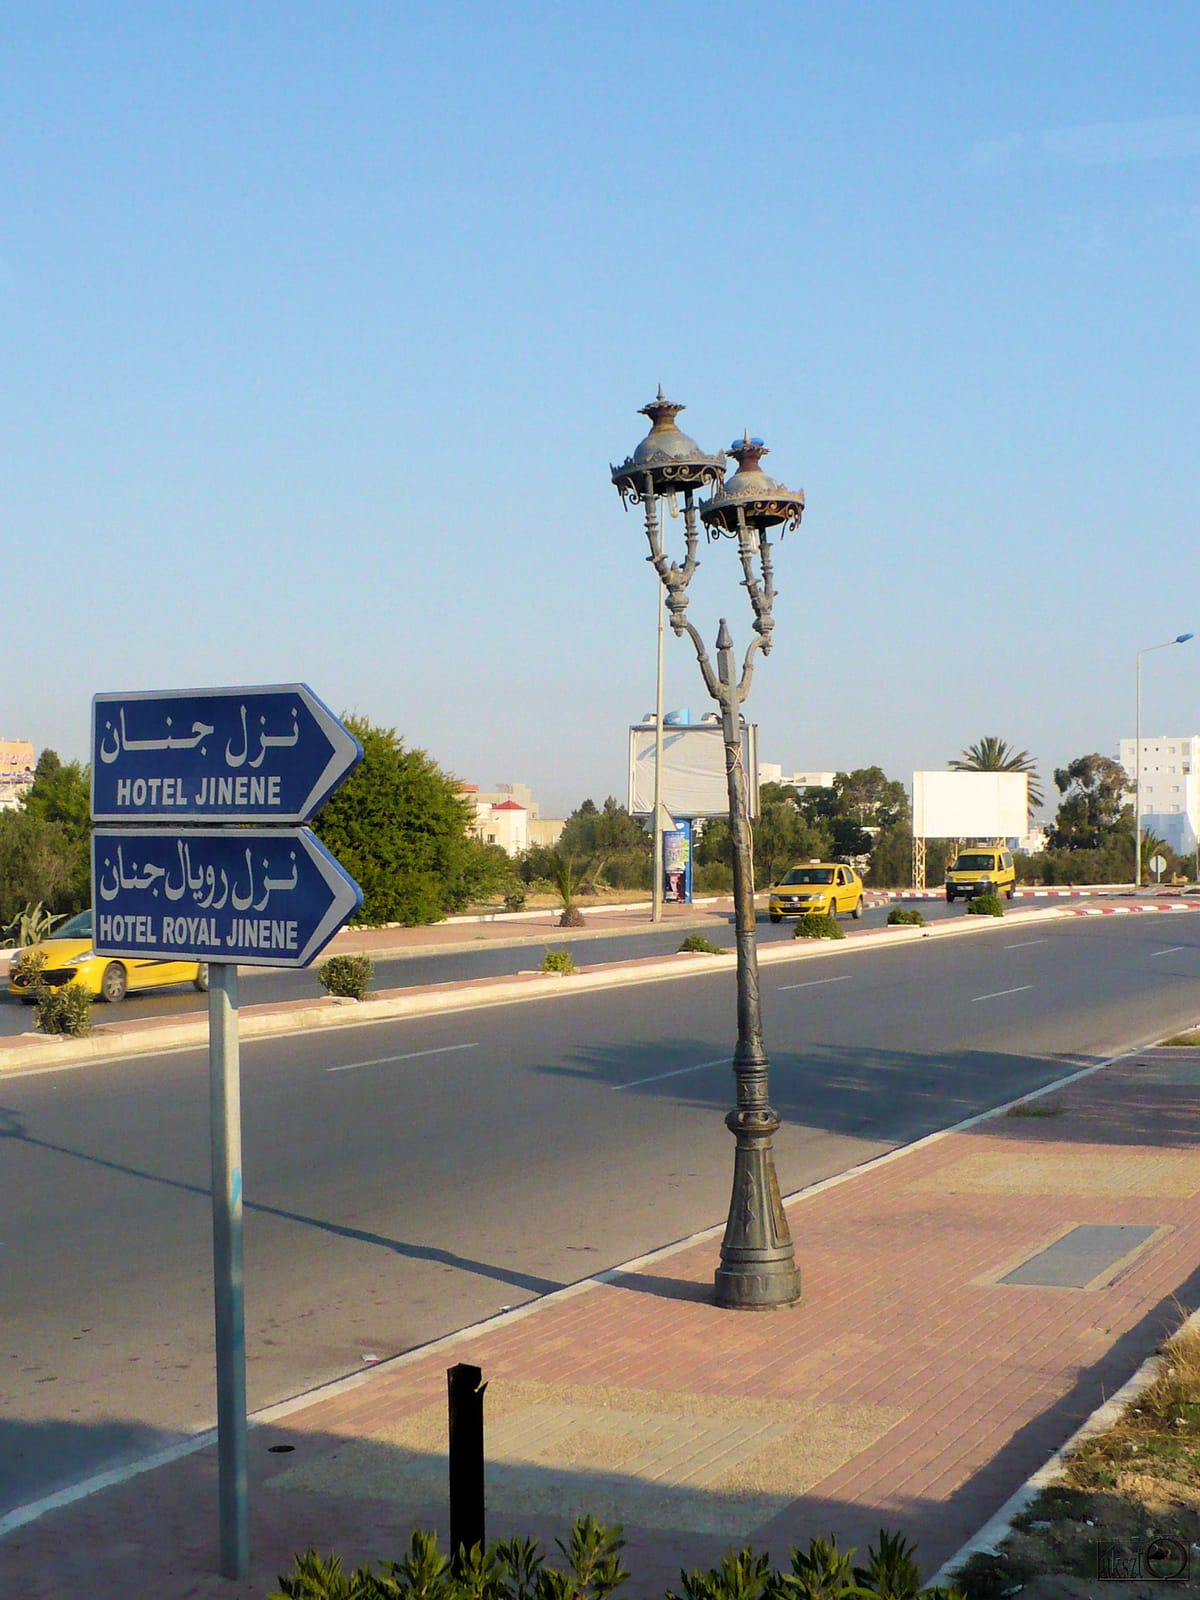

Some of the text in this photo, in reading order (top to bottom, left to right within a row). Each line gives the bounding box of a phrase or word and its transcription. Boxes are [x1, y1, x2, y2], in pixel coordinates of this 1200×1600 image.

[100, 704, 299, 768] نزل جنان
[116, 775, 281, 806] HOTEL JINENE
[100, 839, 298, 912] نزل رويال جنان
[100, 914, 298, 949] HOTEL ROYAL JINENE
